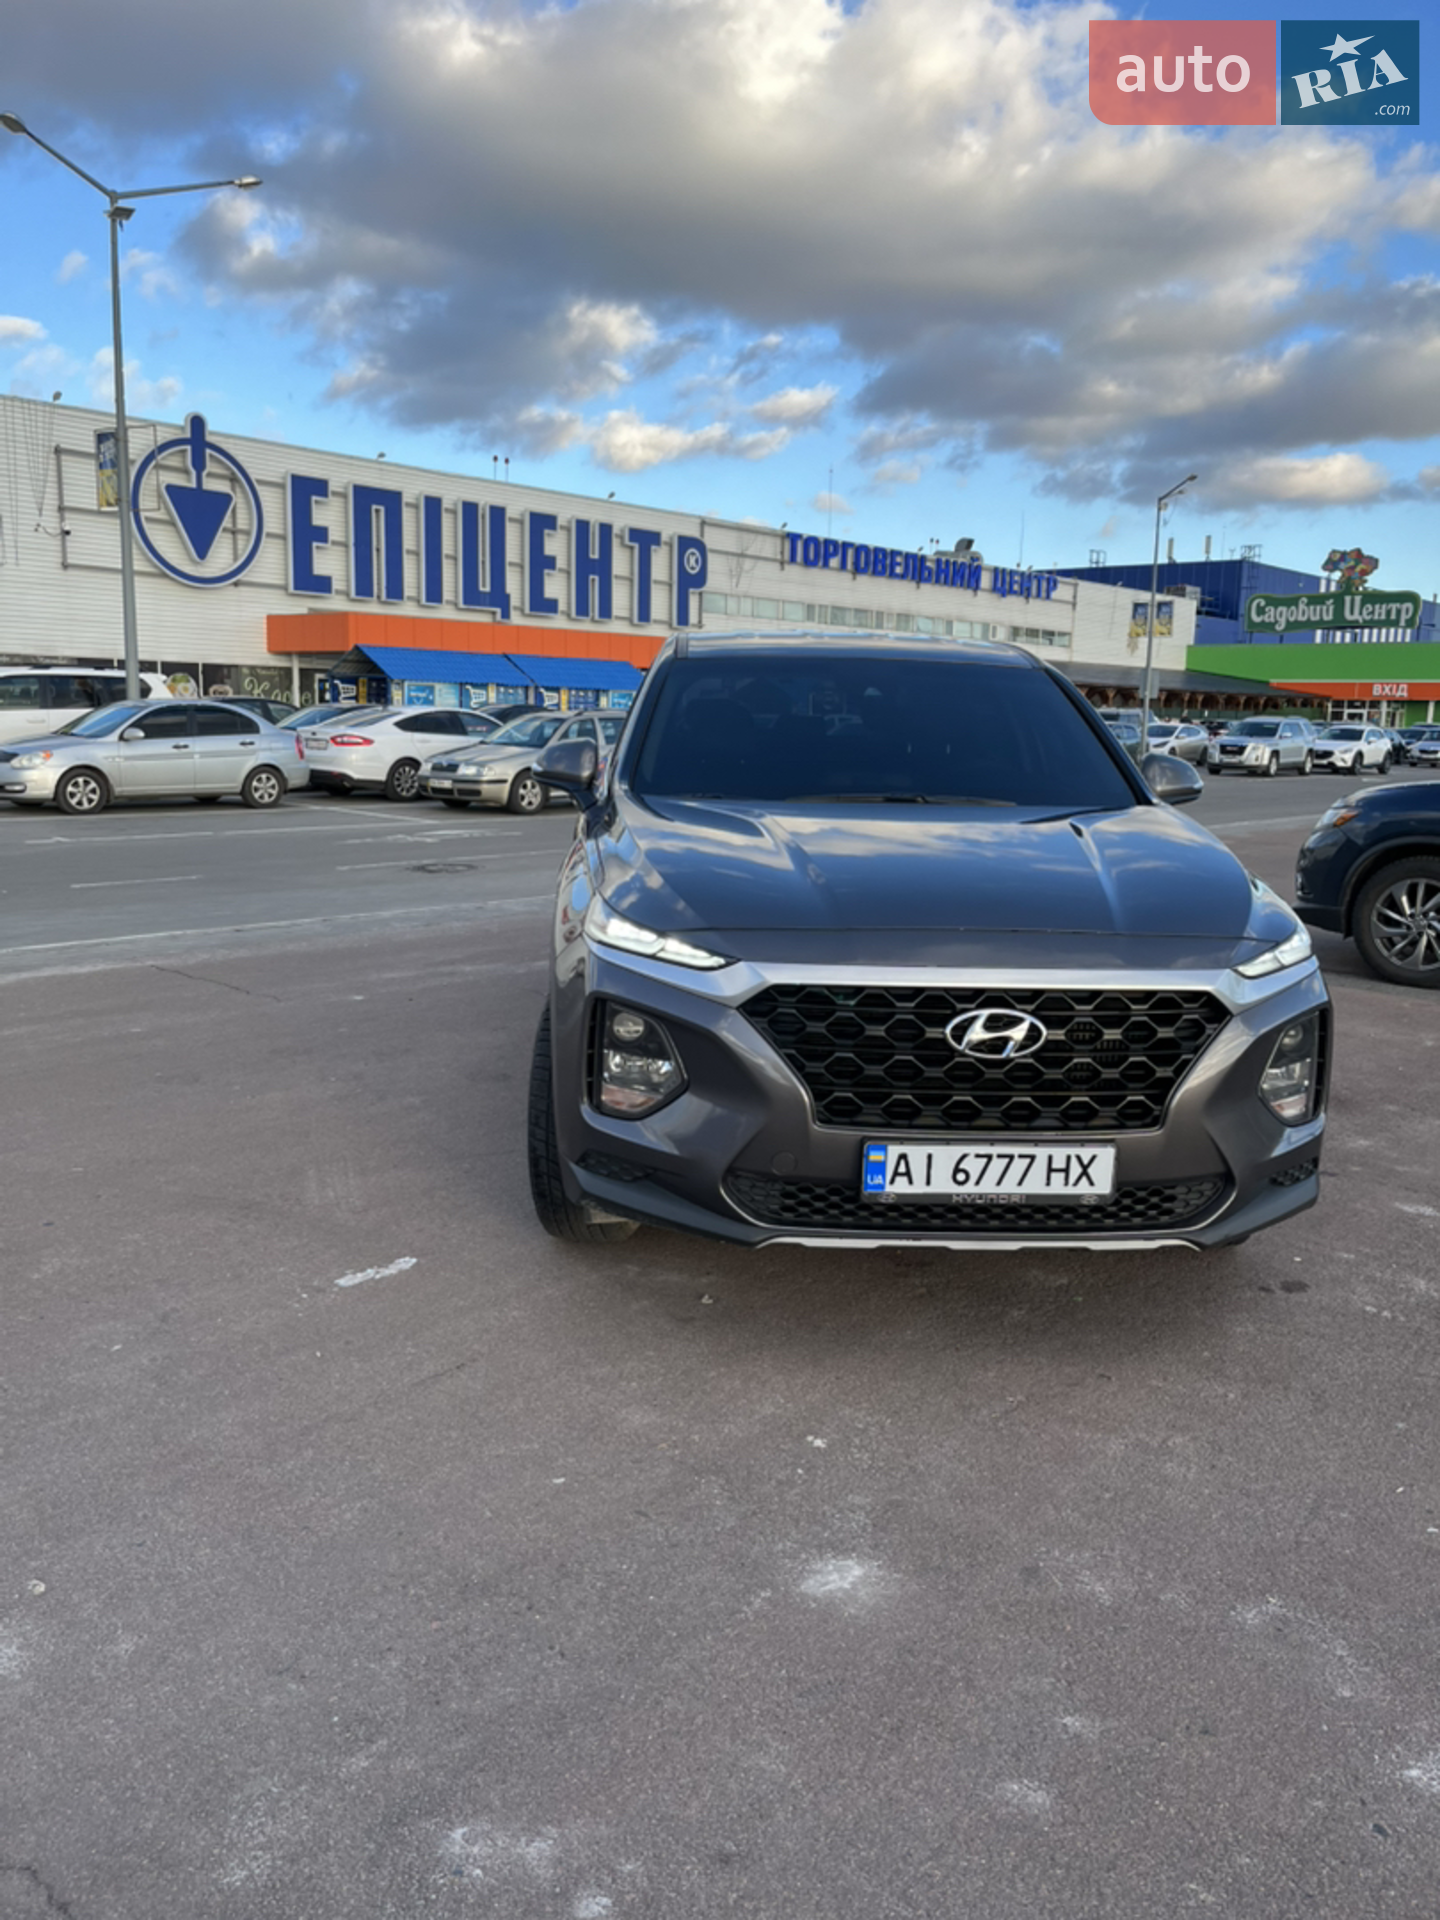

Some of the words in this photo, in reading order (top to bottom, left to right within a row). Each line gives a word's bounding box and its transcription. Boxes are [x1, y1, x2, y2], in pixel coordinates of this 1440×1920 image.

[286, 471, 708, 628] ЕПІЦЕНТР
[785, 531, 983, 591] ТОРГОВЕЛЬНИЙ
[991, 566, 1059, 601] ЦЕНТР
[1250, 597, 1335, 632] Садовий
[1343, 595, 1414, 627] Центр
[1372, 684, 1409, 698] ВХІД
[867, 1174, 884, 1185] UA
[889, 1152, 933, 1187] AI
[951, 1152, 1037, 1187] 6777
[1045, 1153, 1098, 1187] HX
[952, 1194, 1027, 1204] HYUNDAI
